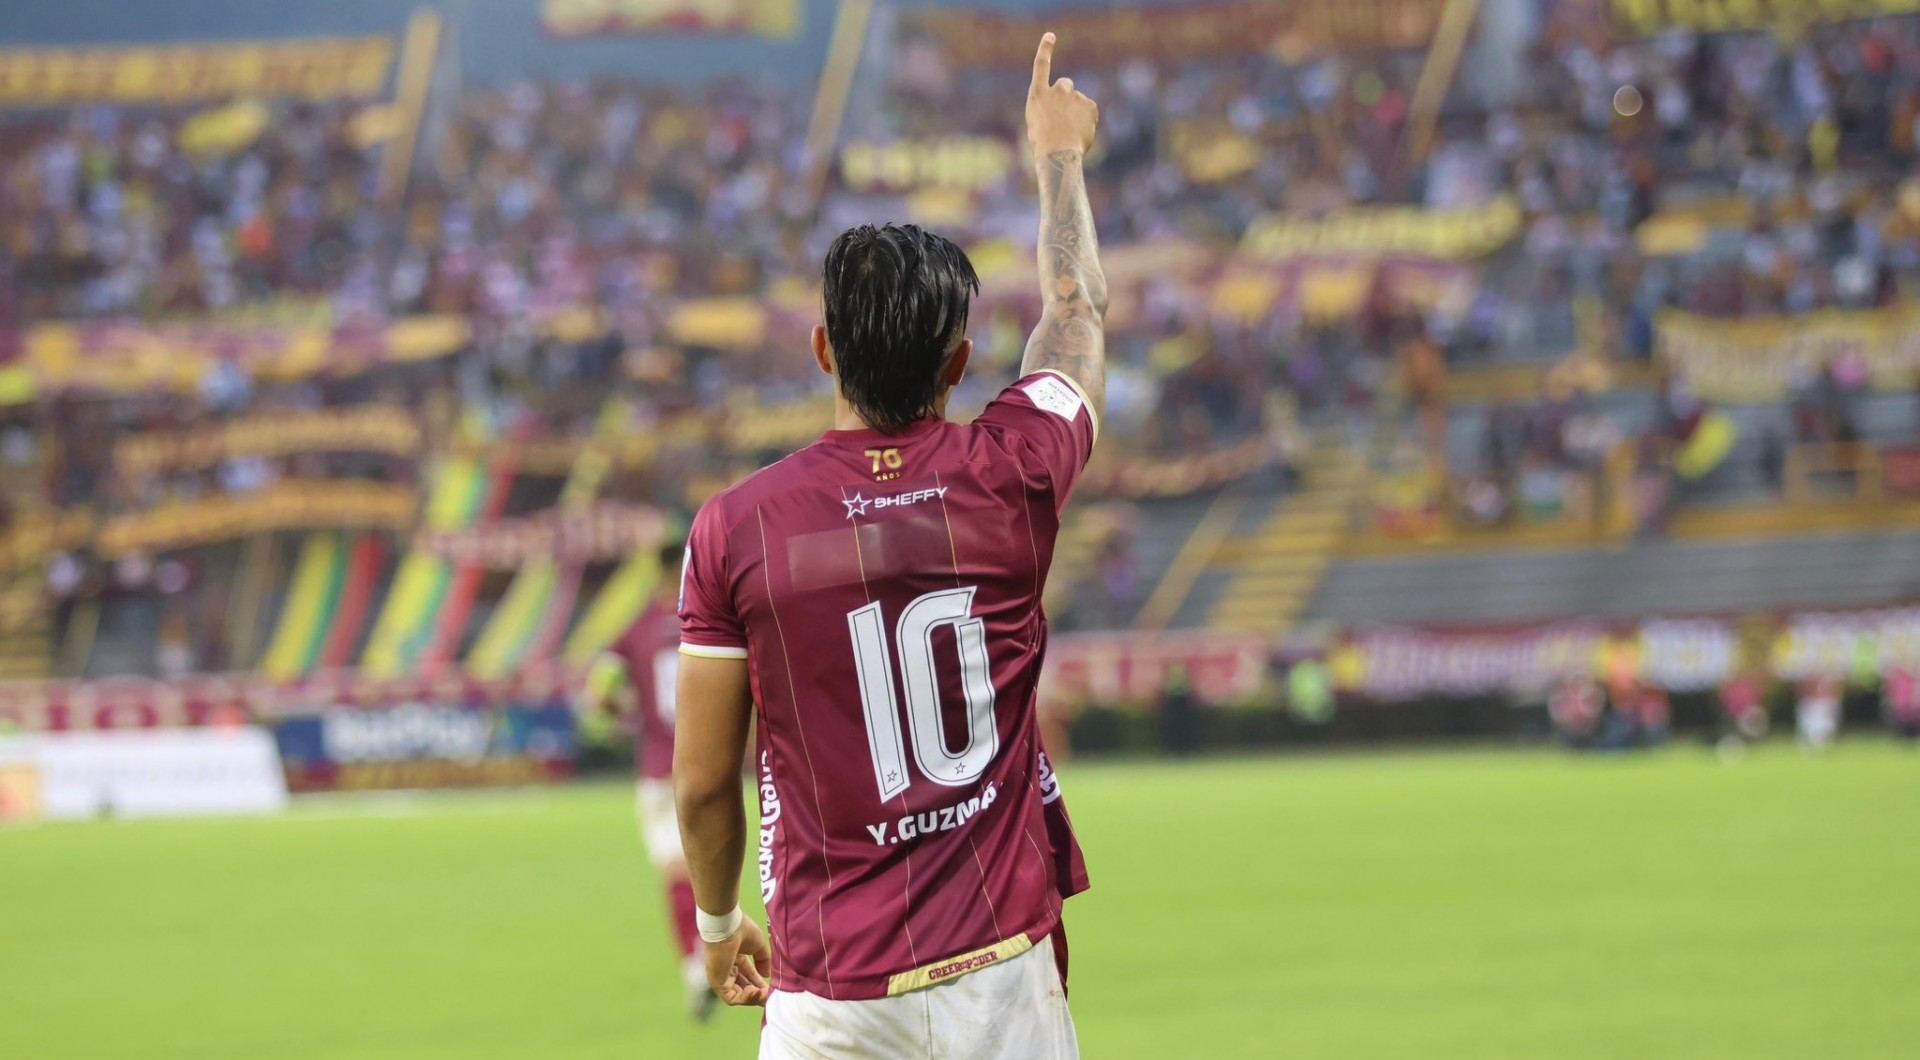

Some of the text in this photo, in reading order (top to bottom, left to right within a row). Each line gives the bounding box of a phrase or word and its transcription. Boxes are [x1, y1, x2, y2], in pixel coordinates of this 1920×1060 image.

[864, 448, 903, 474] 70
[873, 486, 948, 509] SHEFFY
[846, 585, 1000, 804] 10
[866, 781, 1003, 846] Y.GUZMÁ
[928, 962, 962, 980] CREER
